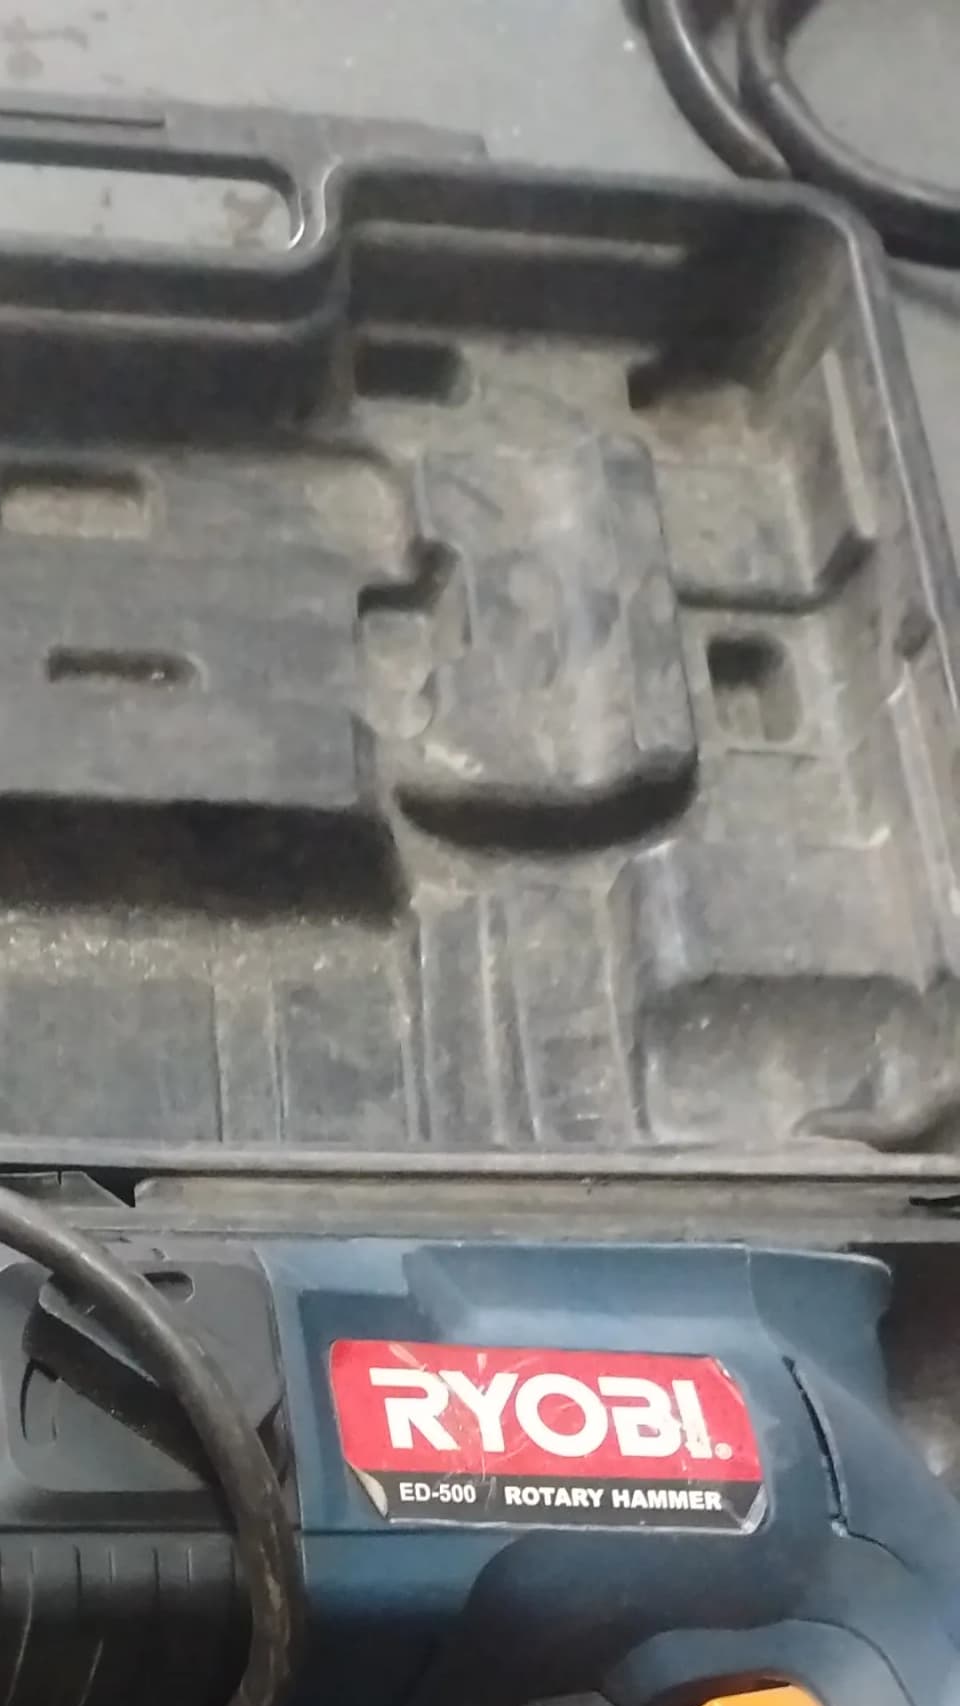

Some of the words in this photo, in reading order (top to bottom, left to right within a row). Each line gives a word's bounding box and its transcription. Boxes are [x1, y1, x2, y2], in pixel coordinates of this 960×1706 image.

[399, 1481, 477, 1504] ED-500
[504, 1485, 604, 1508] ROTARY
[611, 1488, 722, 1511] HAMMER
